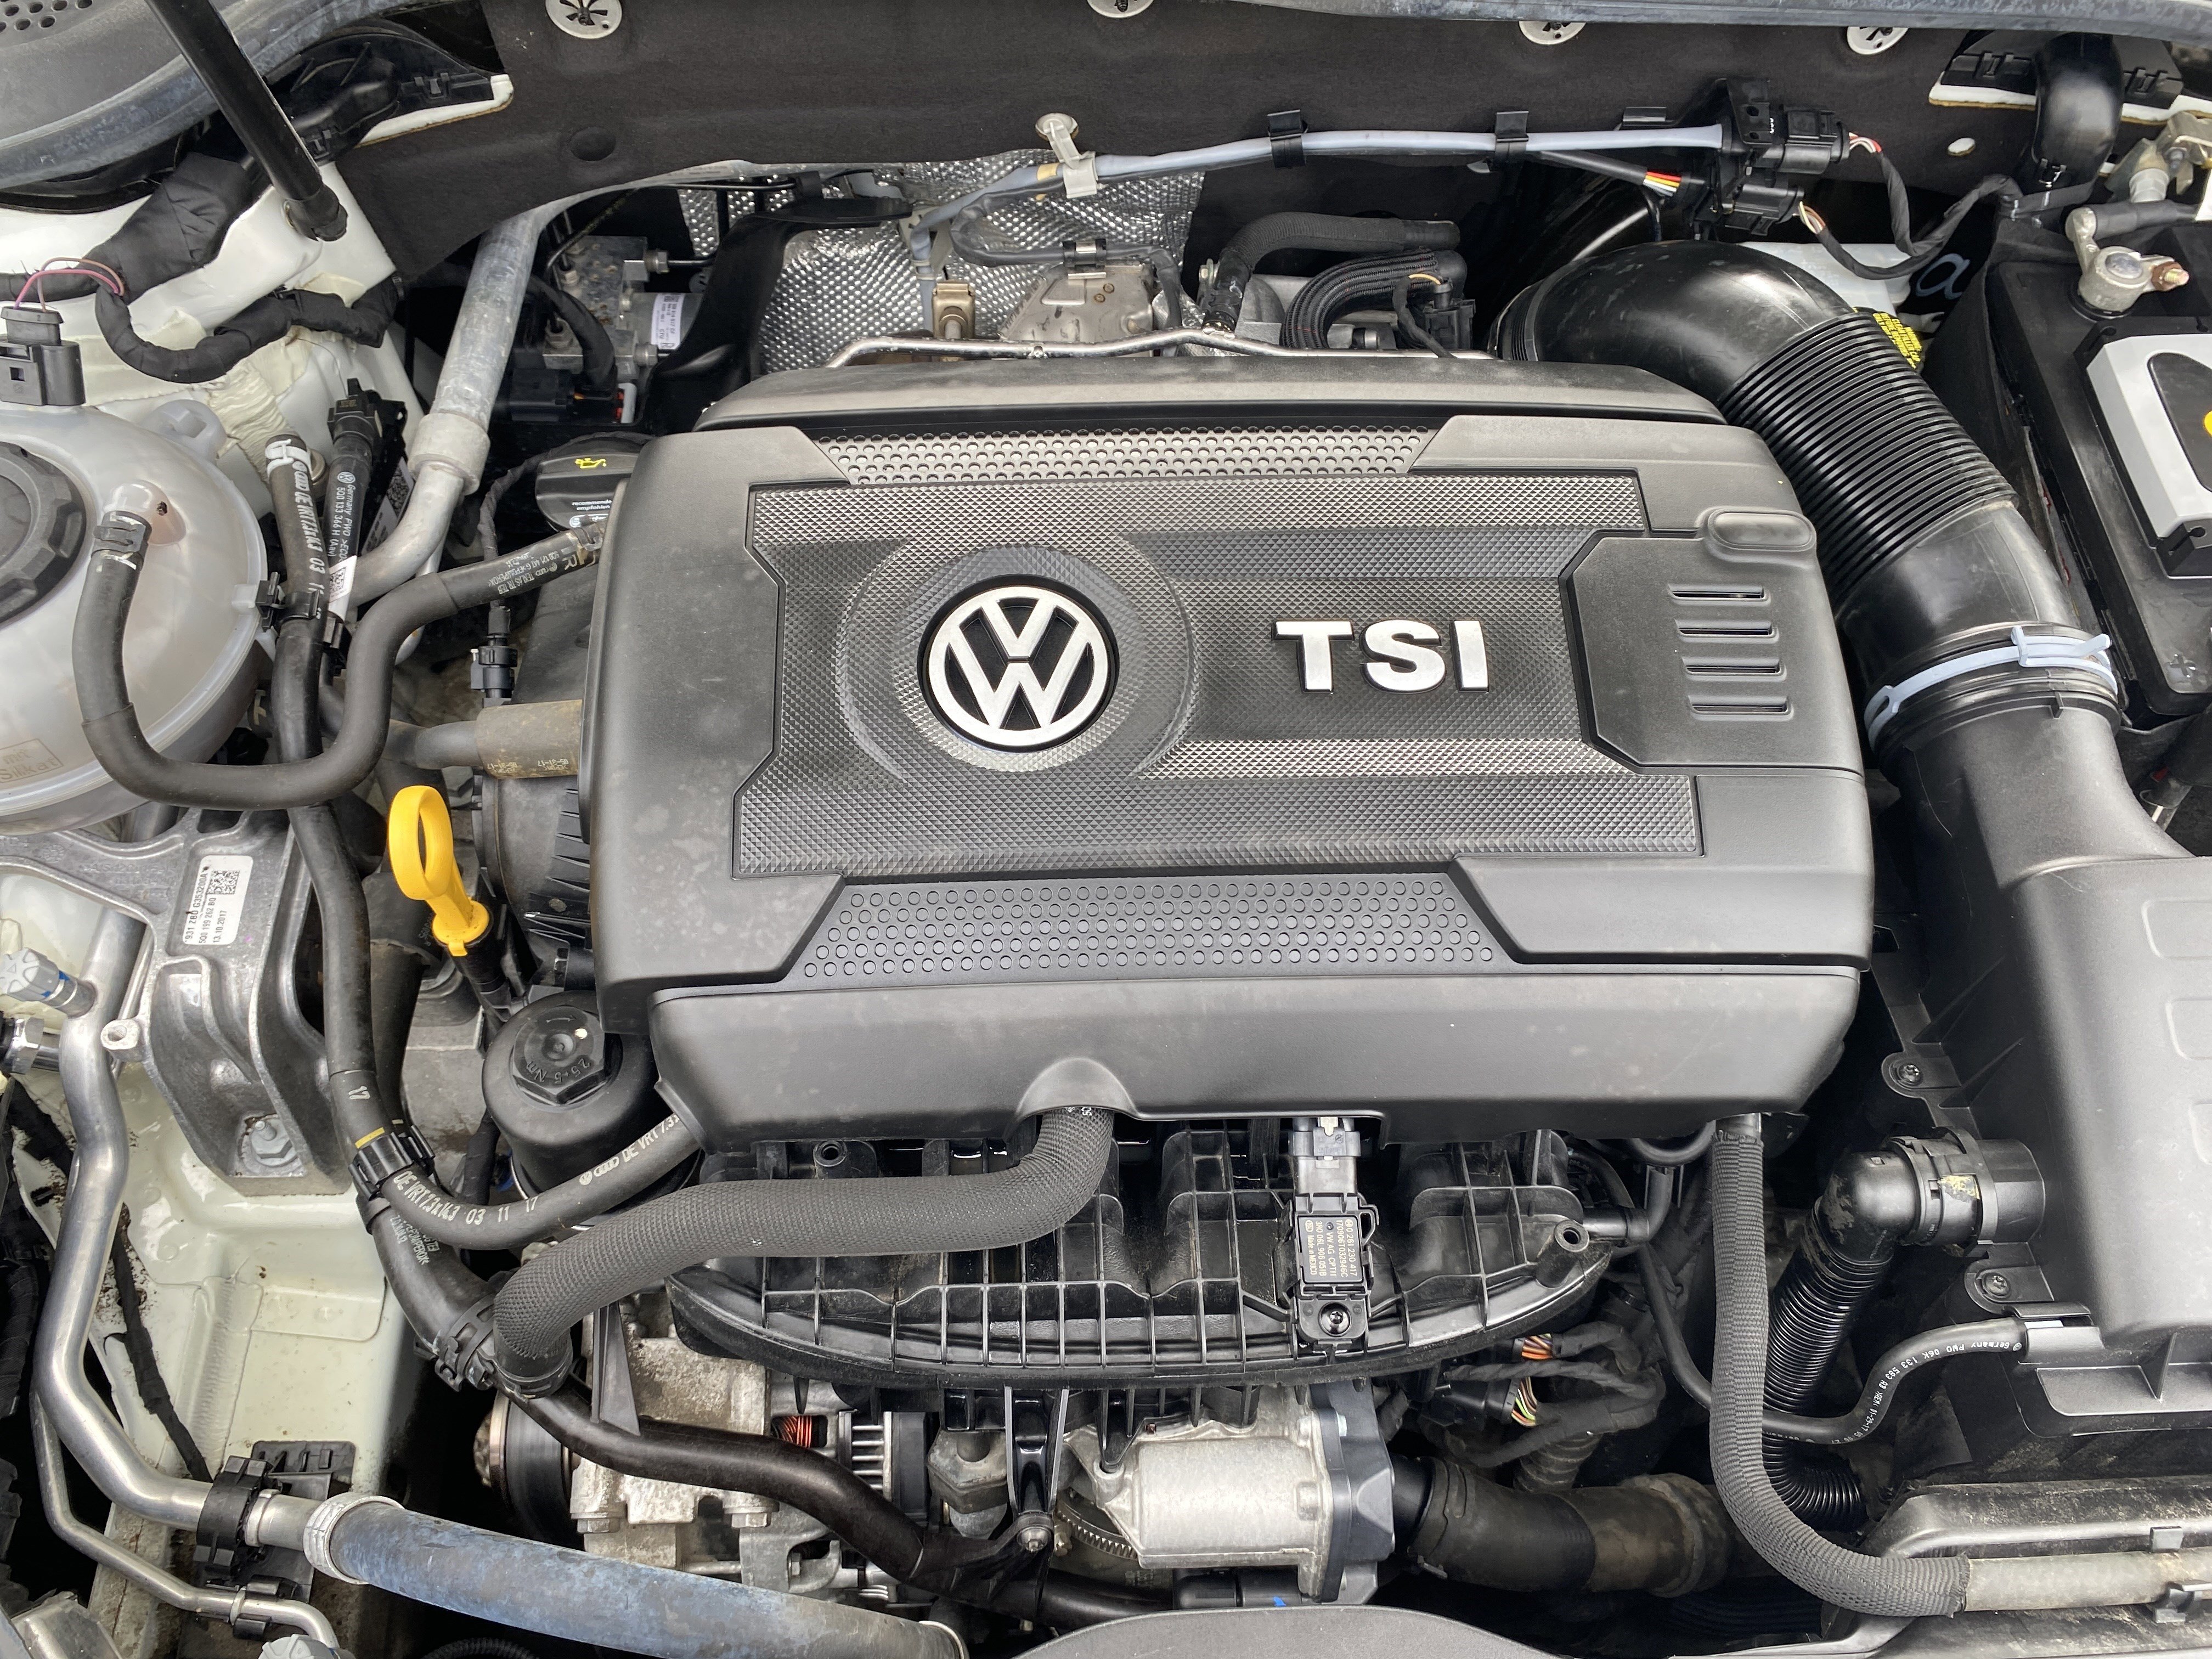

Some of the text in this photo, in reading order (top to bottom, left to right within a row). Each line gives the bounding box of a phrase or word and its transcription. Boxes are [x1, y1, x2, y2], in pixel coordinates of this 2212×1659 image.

[336, 487, 346, 500] 5Q0
[345, 484, 356, 516] Germany
[335, 500, 345, 514] 133
[333, 514, 343, 528] 366
[342, 518, 353, 537] PWO
[309, 557, 326, 574] 03
[926, 585, 1110, 746] VW
[1272, 619, 1491, 695] TSI
[199, 932, 207, 944] 5Q0
[205, 908, 214, 918] 262
[213, 910, 227, 943] 13.10.2017
[623, 1146, 639, 1163] DE
[638, 1130, 659, 1150] VRT
[393, 1171, 417, 1190] DE
[465, 1208, 487, 1226] 03
[498, 1205, 509, 1221] 11
[525, 1197, 539, 1213] 17
[1346, 1234, 1355, 1248] 261
[1348, 1249, 1356, 1262] 230
[1309, 1255, 1317, 1276] MEXICO
[1350, 1265, 1358, 1277] 417
[1900, 1356, 1918, 1369] 133
[1922, 1348, 1940, 1359] 06K
[1861, 1408, 1878, 1431] 01-29-17
